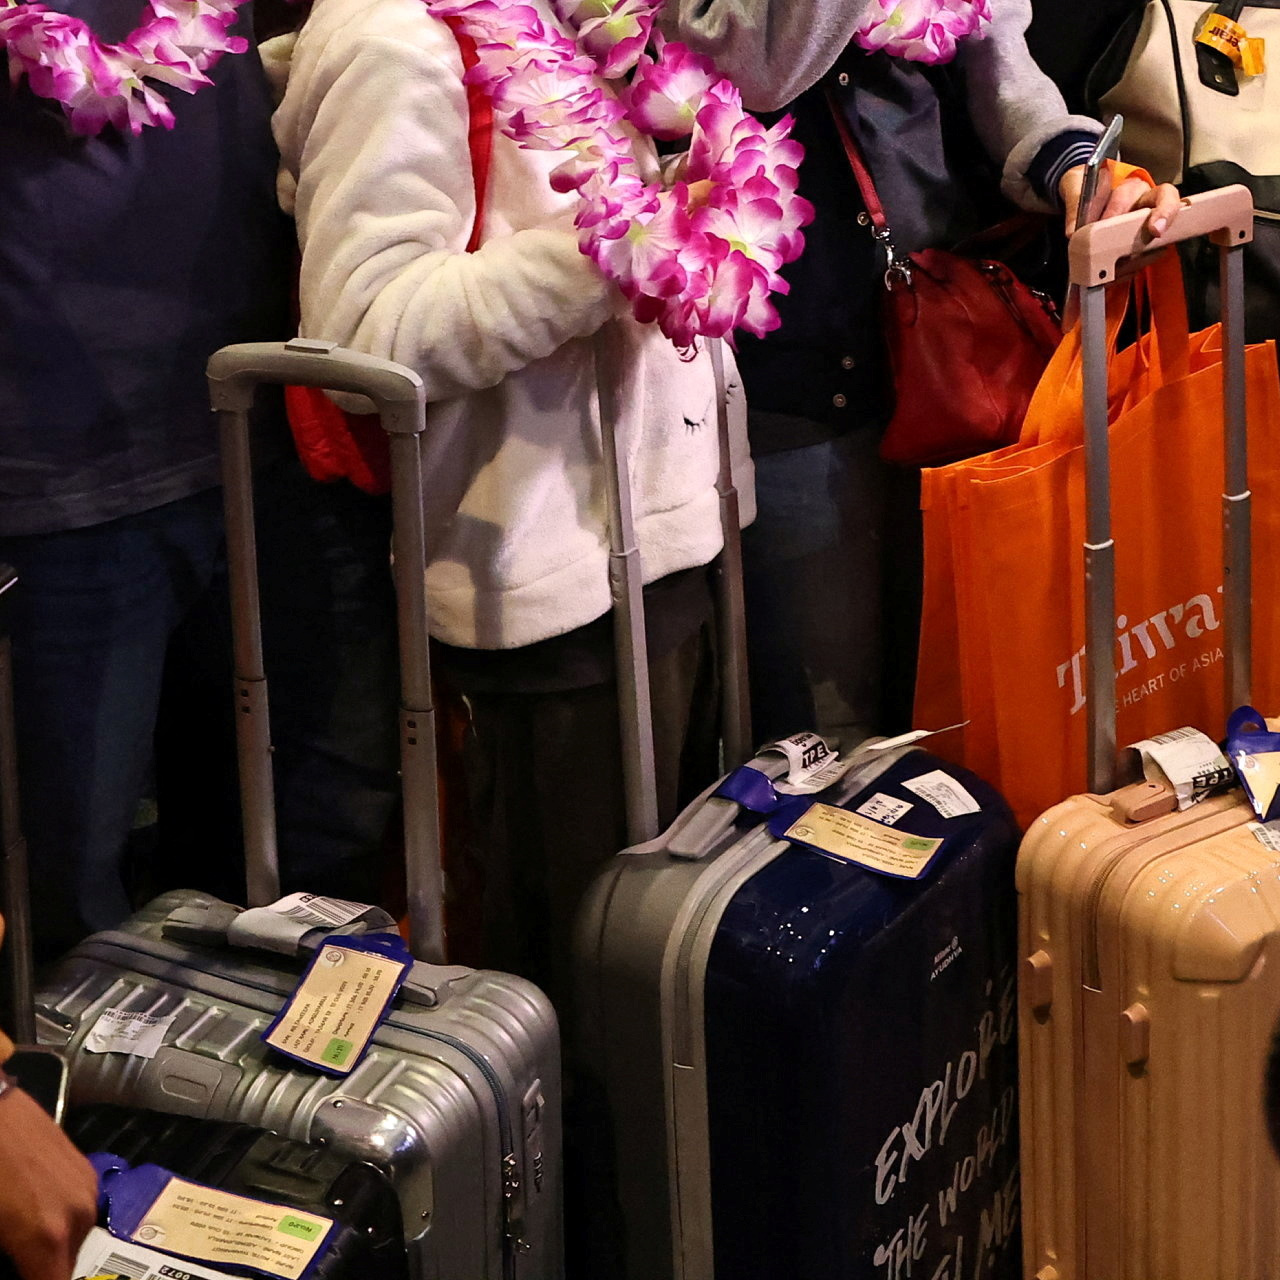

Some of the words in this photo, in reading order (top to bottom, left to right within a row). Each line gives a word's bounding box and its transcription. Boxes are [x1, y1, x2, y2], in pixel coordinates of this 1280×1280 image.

[1122, 673, 1166, 708] HEART
[1169, 663, 1187, 683] OF
[1192, 647, 1225, 673] ASIA
[803, 745, 826, 766] TPE
